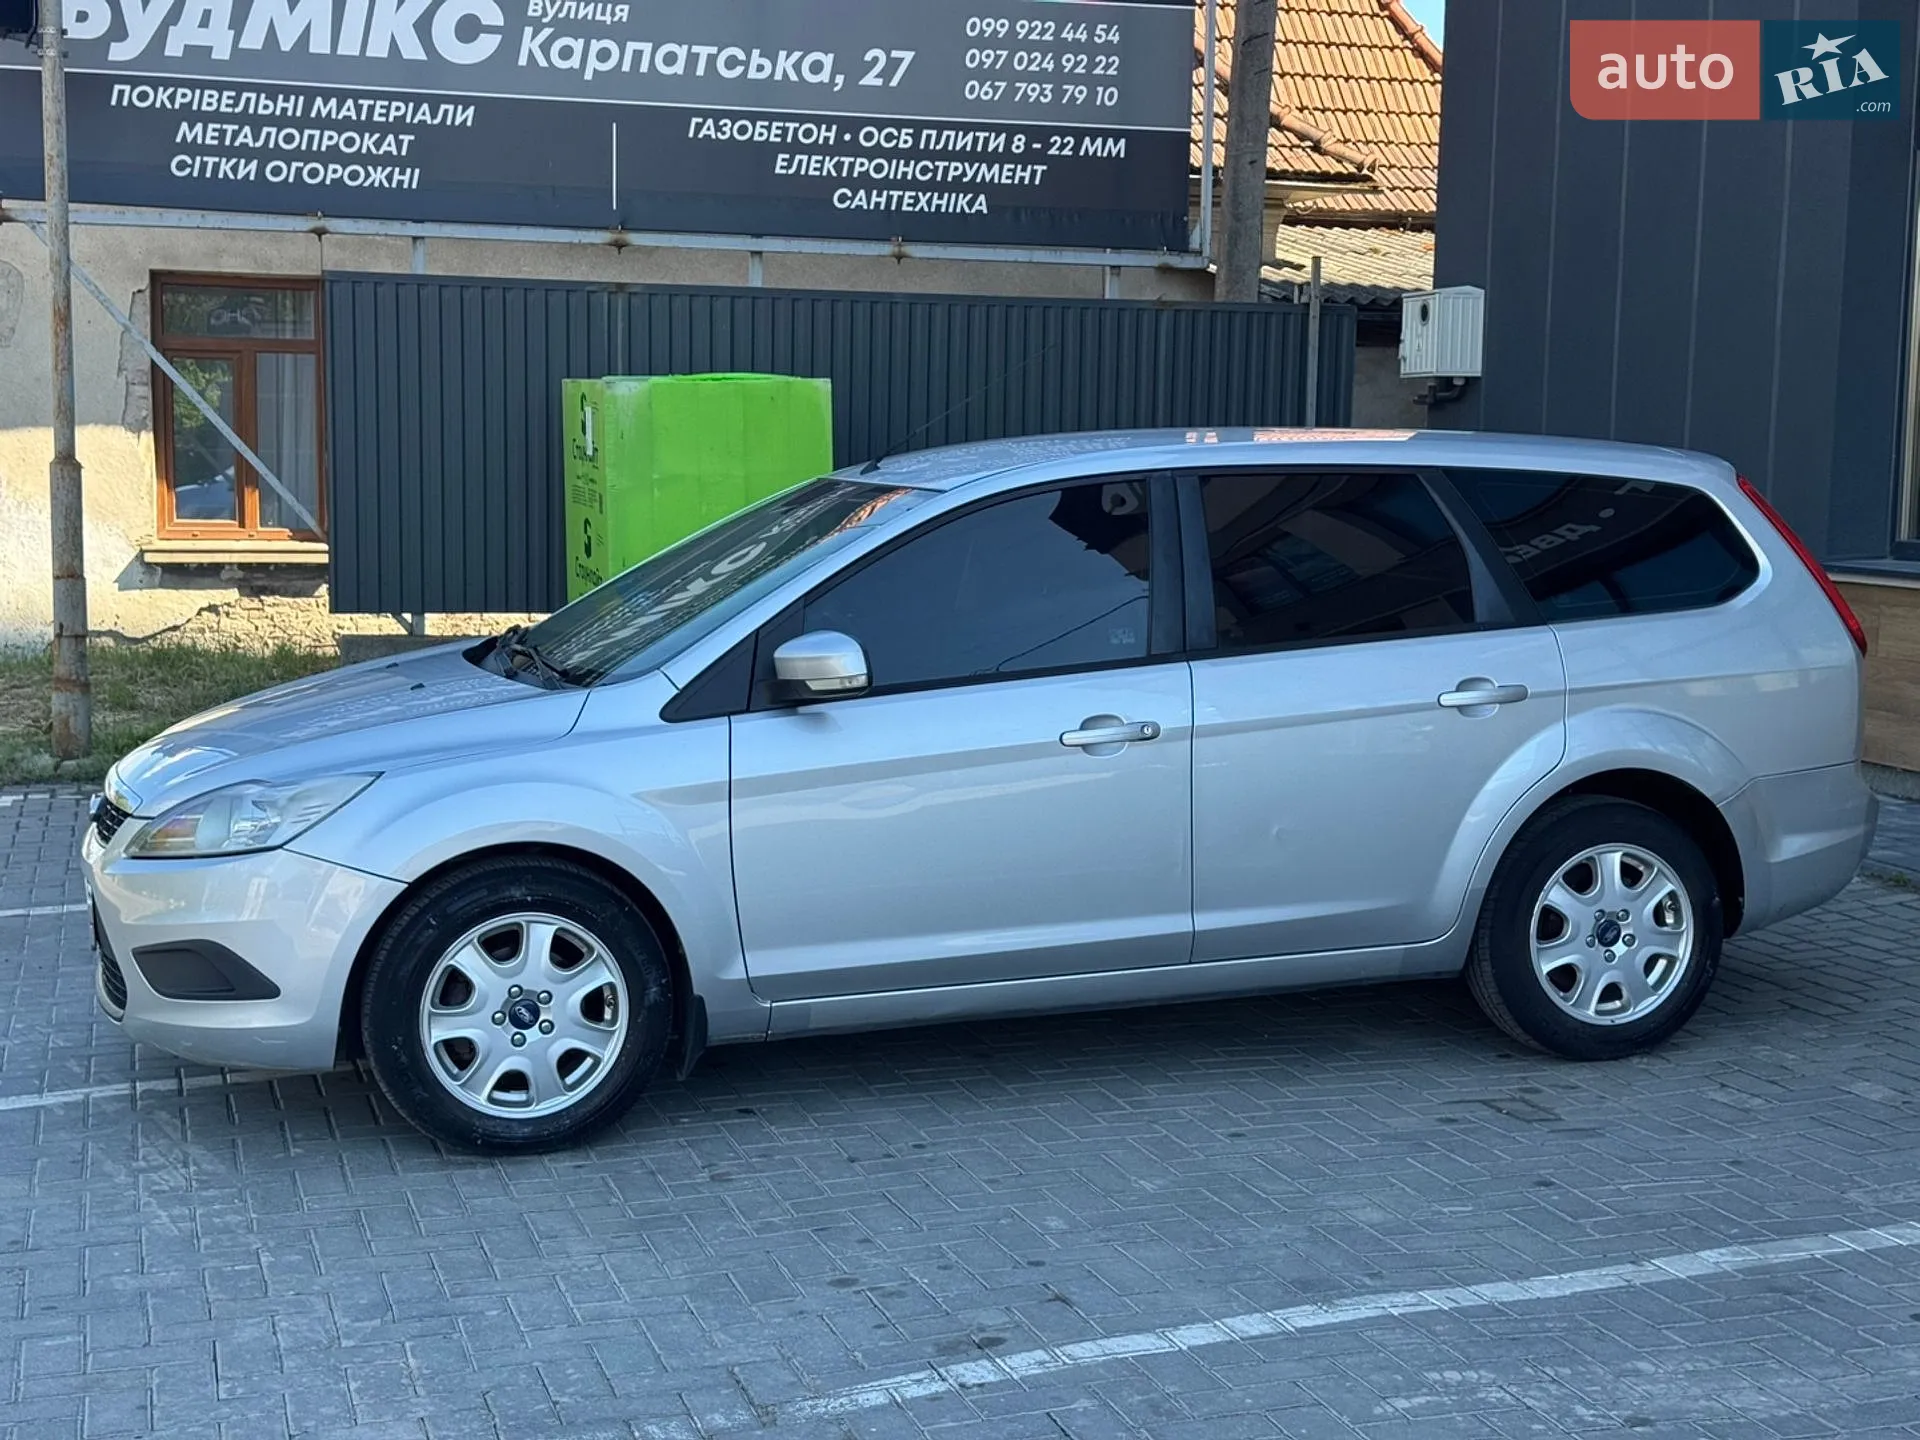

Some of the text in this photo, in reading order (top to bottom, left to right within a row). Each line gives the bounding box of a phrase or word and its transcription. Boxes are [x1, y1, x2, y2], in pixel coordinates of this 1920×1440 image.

[527, 0, 630, 25] вулиця
[966, 17, 1119, 44] 099 922 44 54
[518, 26, 915, 86] Карпатська, 27
[966, 49, 1119, 75] 097 024 92 22
[111, 85, 474, 126] ПОКРІВЕЛЬНІ МАТЕРІАЛИ
[965, 80, 1118, 106] 067 793 79 10
[176, 122, 415, 155] МЕТАЛОПРОКАТ
[689, 118, 837, 144] ГАЗОБЕТОН
[859, 127, 913, 148] ОСБ
[920, 130, 1006, 152] ПЛИТИ
[1012, 135, 1025, 153] 8
[1048, 136, 1074, 155] 22
[1080, 137, 1125, 157] ММ
[171, 155, 419, 189] СІТКИ ОГОРОЖНІ
[775, 154, 1047, 184] ЕЛЕКТРОІНСТРУМЕНТ
[834, 188, 987, 213] САНТЕХНІКА
